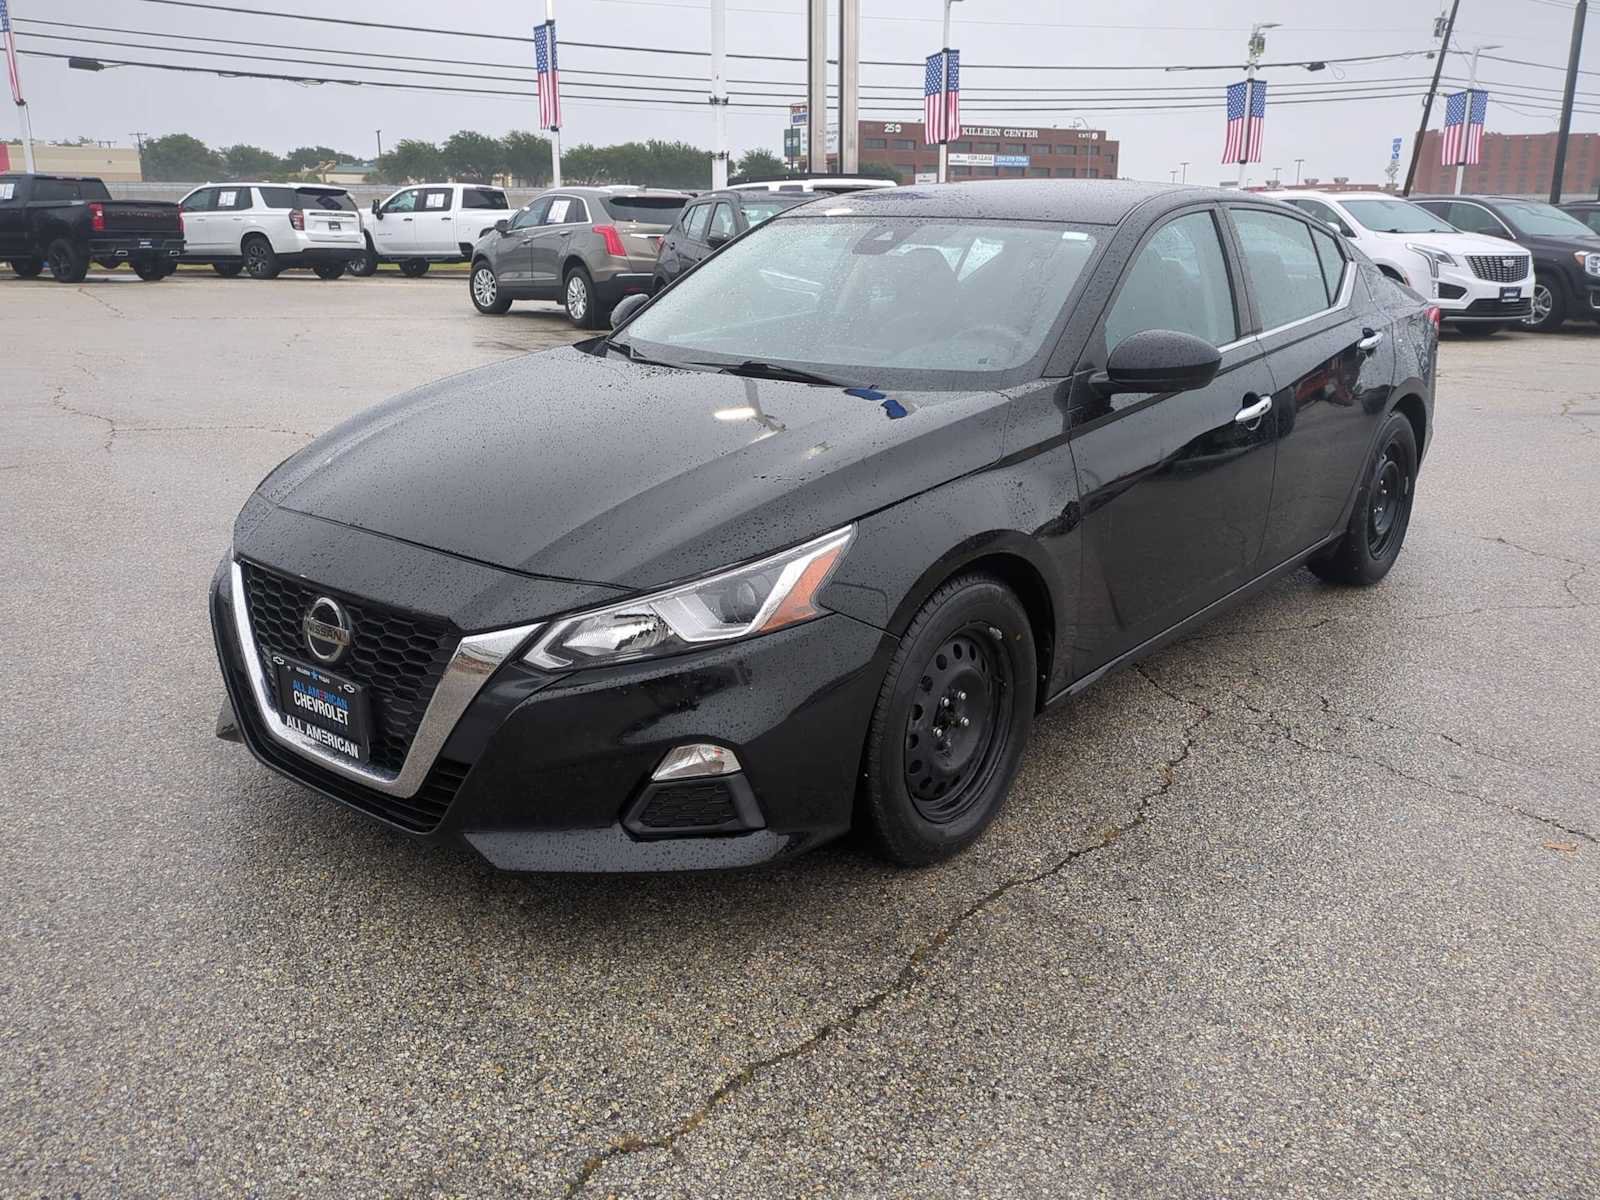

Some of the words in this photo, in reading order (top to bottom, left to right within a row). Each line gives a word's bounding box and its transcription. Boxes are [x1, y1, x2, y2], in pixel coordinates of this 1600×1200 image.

[962, 127, 1000, 137] KILLEEN
[1003, 129, 1038, 138] CENTER
[308, 619, 342, 641] NISSAN
[292, 680, 307, 693] ALL
[308, 686, 349, 710] AMERICAN
[294, 690, 349, 725] CHEVROLET
[286, 715, 305, 734] ALL
[306, 723, 359, 759] AMERICAN
